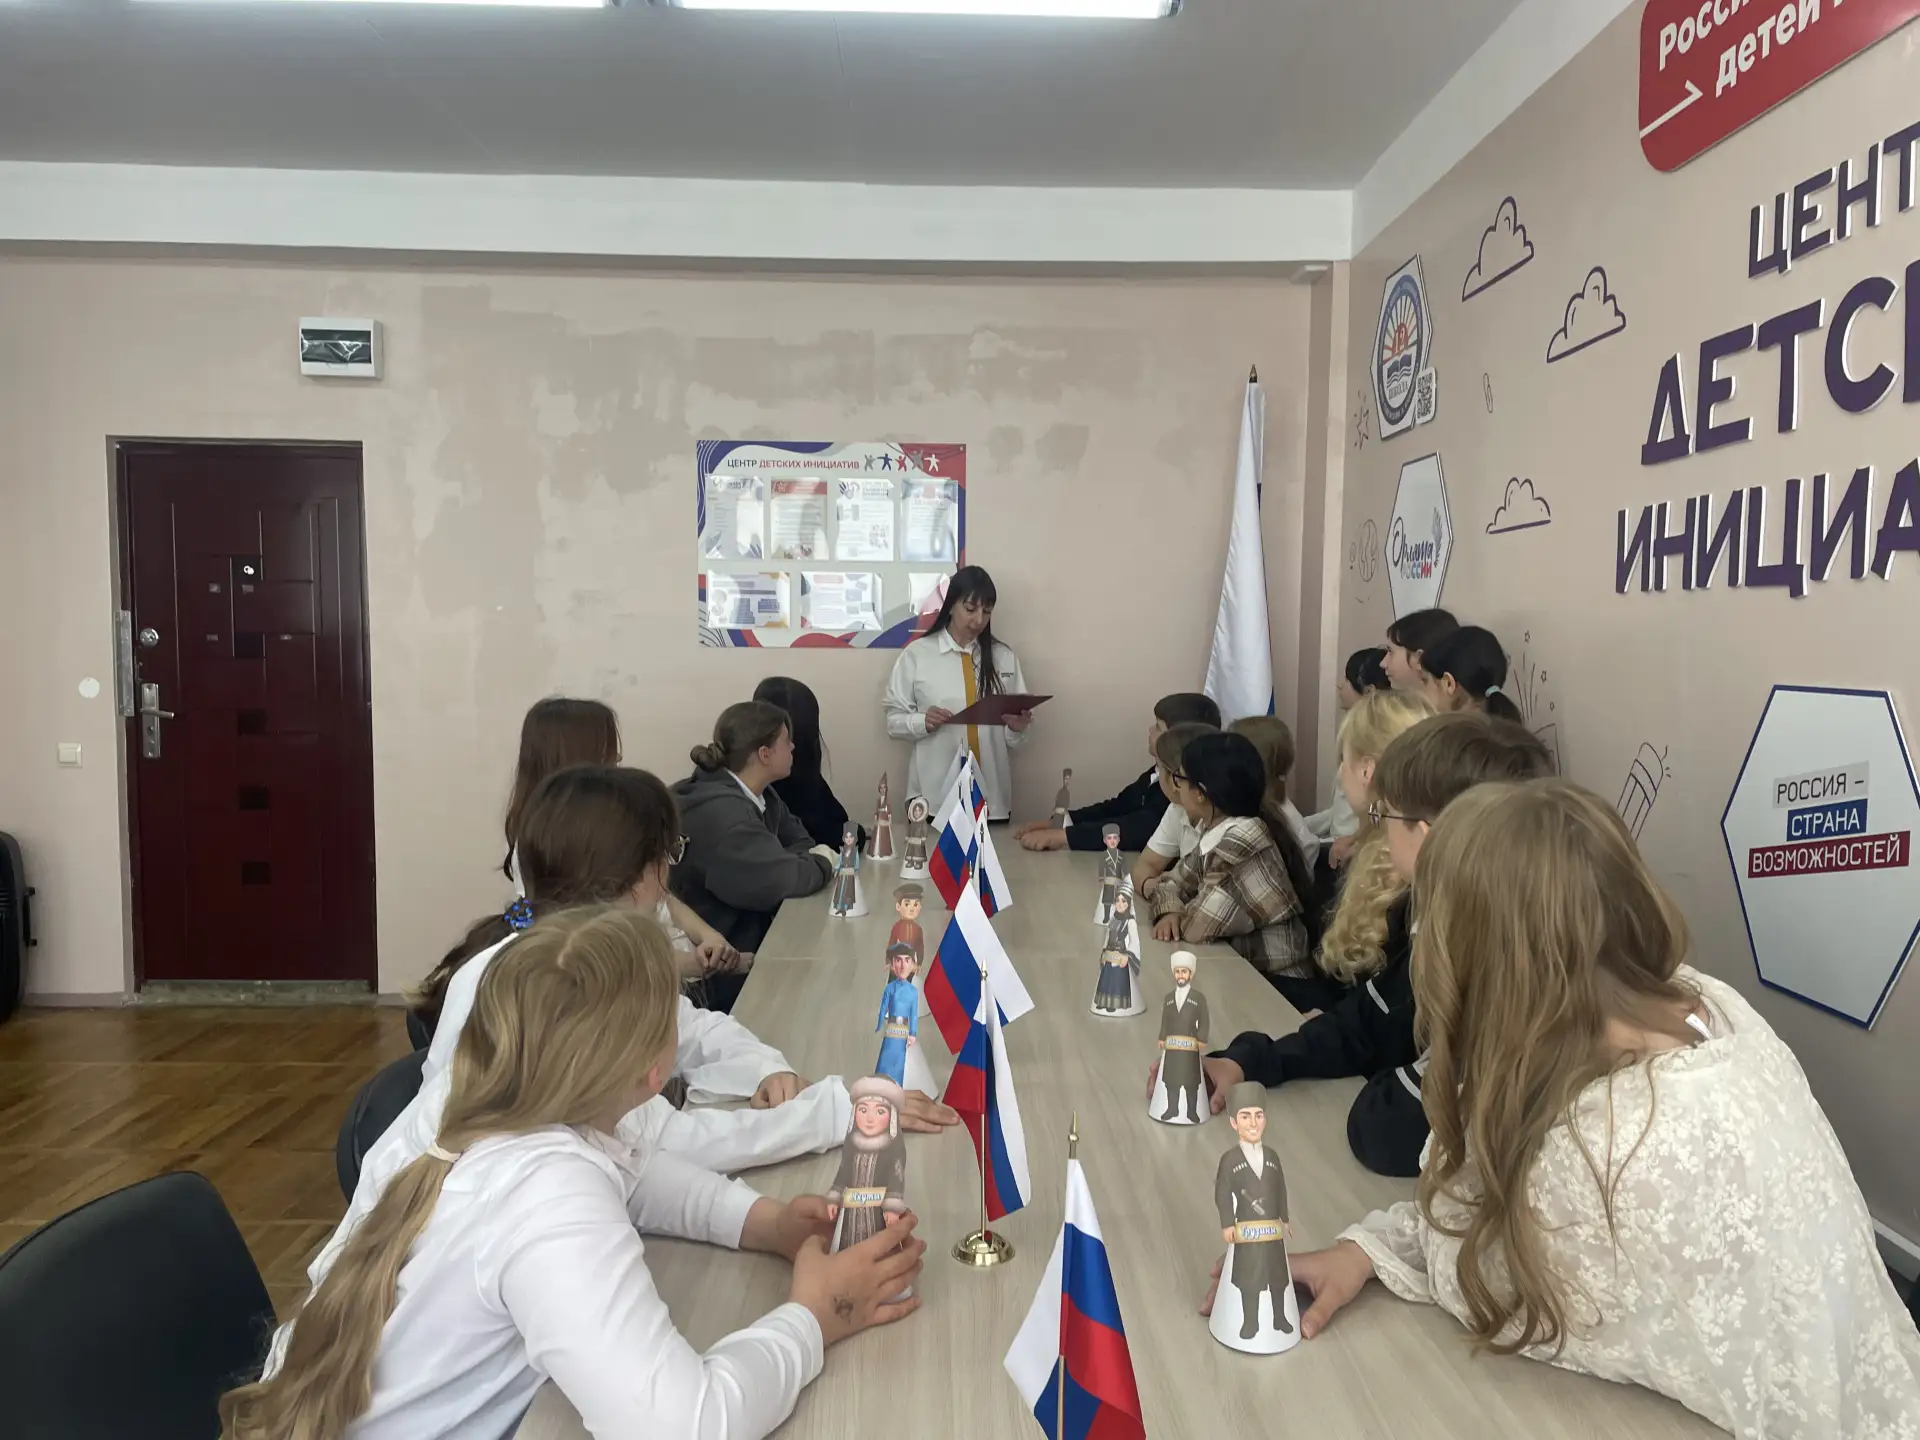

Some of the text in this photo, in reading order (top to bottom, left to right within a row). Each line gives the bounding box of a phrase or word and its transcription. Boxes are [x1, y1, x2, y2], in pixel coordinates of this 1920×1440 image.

[1658, 0, 1748, 71] Росс
[1641, 257, 1920, 466] ДЕТС
[727, 459, 860, 470] ЦЕНТР ДЕТСКИХ ИНИЦИАТИВ
[1777, 772, 1847, 804] РОССИЯ
[1791, 807, 1860, 837] СТРАНА
[1752, 832, 1901, 873] ВОЗМОЖНОСТЕЙ
